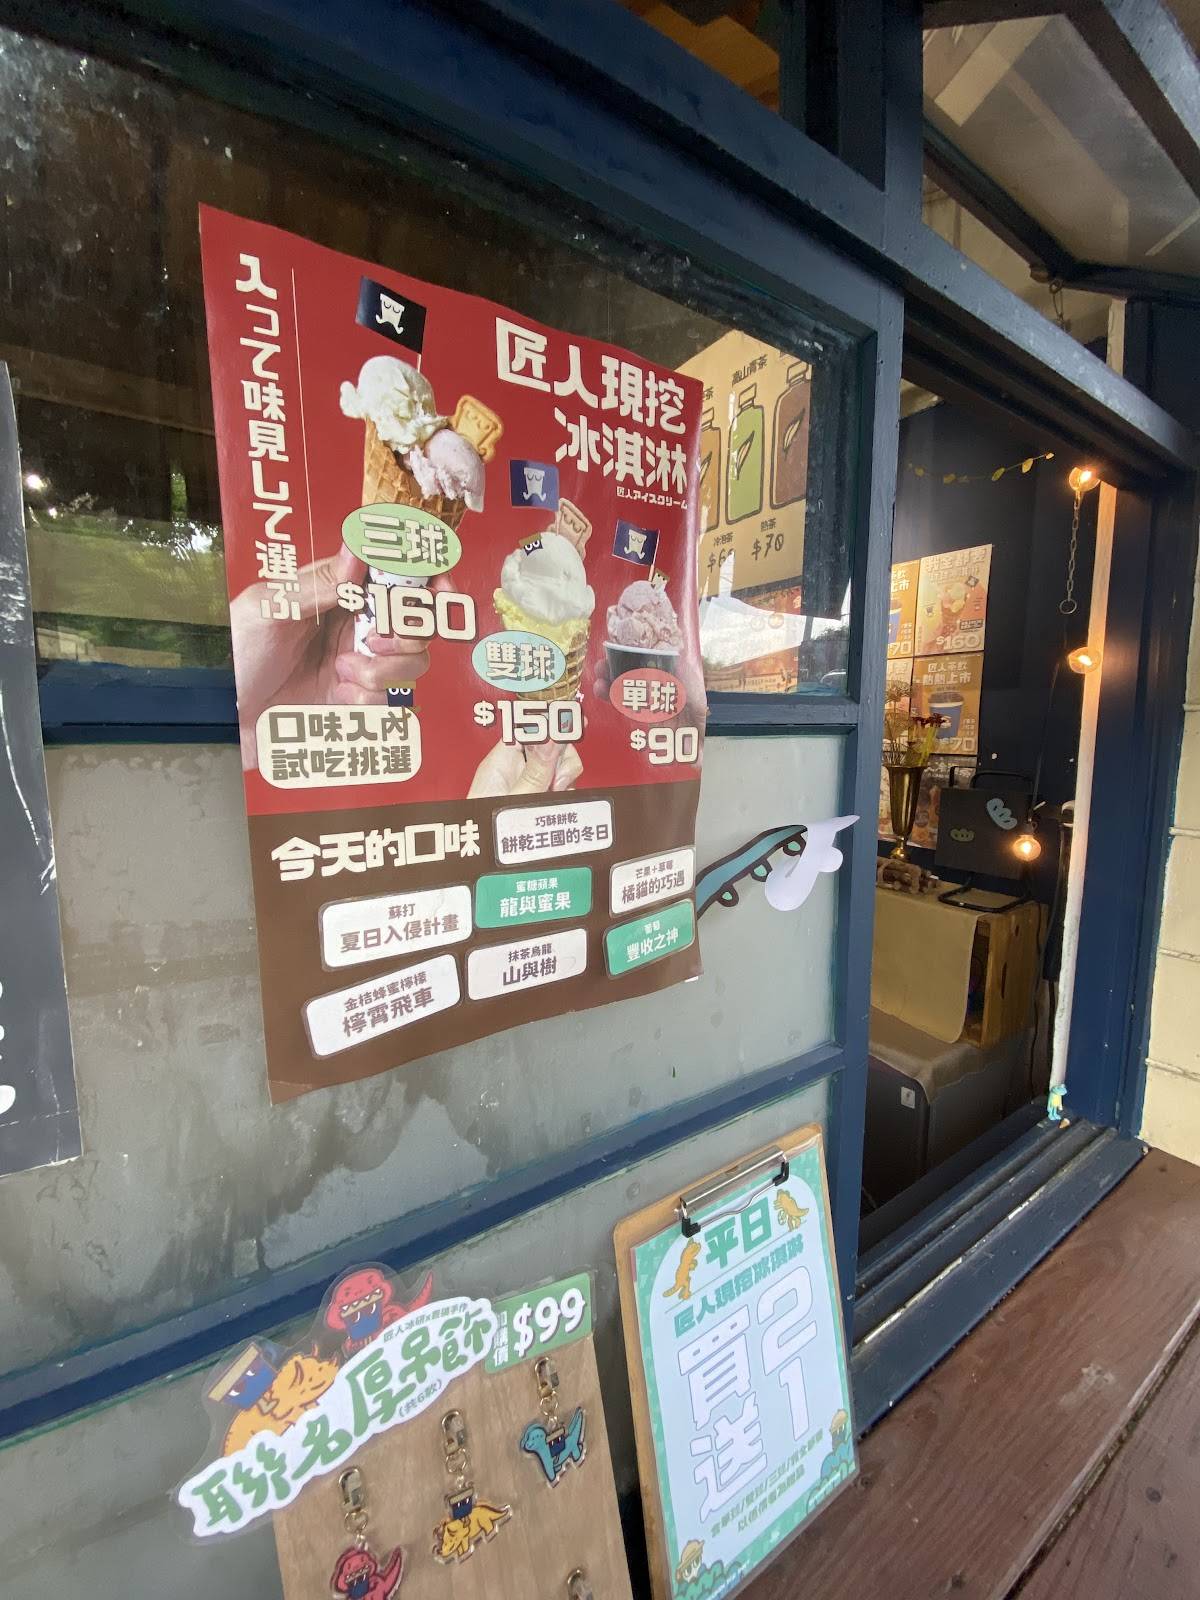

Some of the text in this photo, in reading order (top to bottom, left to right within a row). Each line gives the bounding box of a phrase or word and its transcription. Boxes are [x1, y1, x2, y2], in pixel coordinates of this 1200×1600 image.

[496, 317, 686, 434] 匠人現挖
[235, 253, 301, 621] 入って味見して選ぶ
[554, 407, 687, 494] 冰淇淋
[616, 486, 688, 509] 匠人アイスクリーム
[360, 512, 449, 567] 三球
[752, 533, 784, 560] $70
[707, 548, 735, 573] $6
[337, 581, 476, 640] $160
[485, 641, 556, 682] 雙球
[622, 678, 677, 714] 單球
[269, 707, 410, 743] 口味入內
[473, 700, 582, 745] $150
[271, 746, 412, 780] 試吃挑選
[630, 726, 699, 765] $90
[535, 812, 578, 827] 巧酥餅乾
[271, 820, 481, 881] 今天的口味
[501, 824, 609, 854] 餅乾王國的冬日
[516, 877, 559, 893] 蜜糖蘋果
[622, 870, 685, 904] 橘貓的巧遇
[388, 903, 416, 921] 蘇打
[499, 891, 572, 918] 龍與蜜果
[340, 914, 460, 954] 夏日入侵計畫
[626, 927, 679, 962] 豐收之神
[502, 956, 557, 985] 山與樹
[508, 943, 553, 962] 抹茶烏龍
[344, 971, 428, 1013] 金桔蜂蜜檸檬
[342, 986, 434, 1037] 檸霄飛車
[705, 1197, 772, 1269] 平日
[513, 1287, 586, 1358] $99
